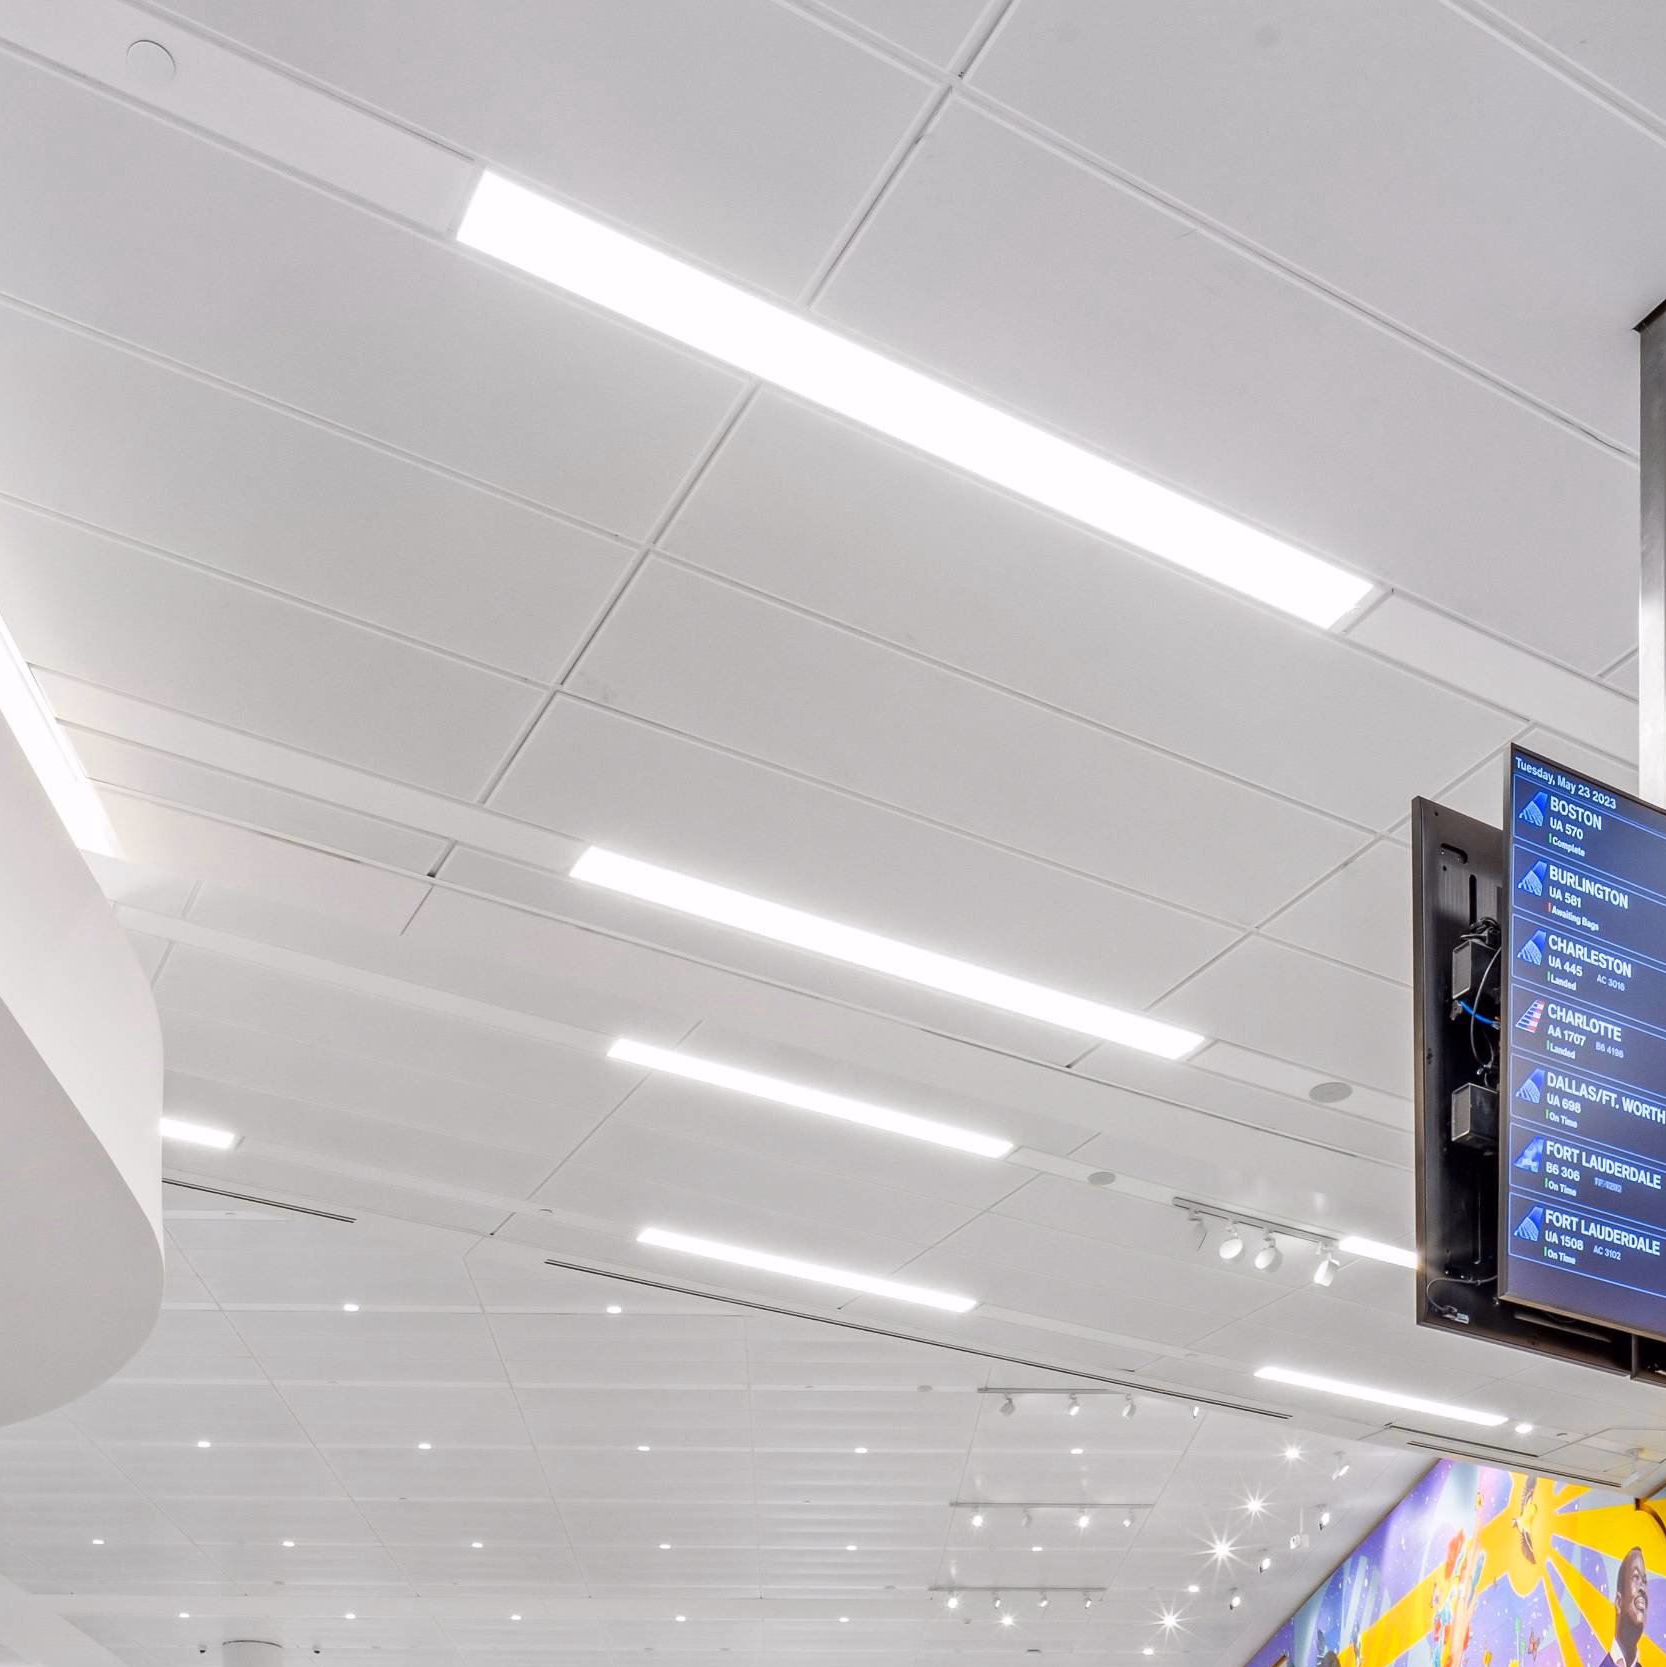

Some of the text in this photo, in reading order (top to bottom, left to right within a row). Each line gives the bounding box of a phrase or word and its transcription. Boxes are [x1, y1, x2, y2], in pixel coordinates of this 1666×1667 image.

[1515, 756, 1616, 809] Tuesday, May 23 2023
[1549, 816, 1583, 839] UA 570
[1550, 795, 1601, 830] BOSTON
[1549, 864, 1628, 909] BURLINGTON
[1549, 885, 1581, 908] UA 581
[1548, 934, 1631, 977] CHARLESTON
[1548, 955, 1582, 976] UA 445
[1547, 1003, 1621, 1042] CHARLOTTE
[1547, 1024, 1586, 1046] AA 1707
[1546, 1092, 1581, 1113] UA 698
[1547, 1071, 1665, 1124] DALLAS/FT. WORTH
[1546, 1140, 1661, 1189] FORT LAUDERDALE
[1546, 1161, 1580, 1181] B6 306
[1545, 1209, 1660, 1255] FORT LAUDERDALE
[1545, 1230, 1583, 1250] UA 1508
